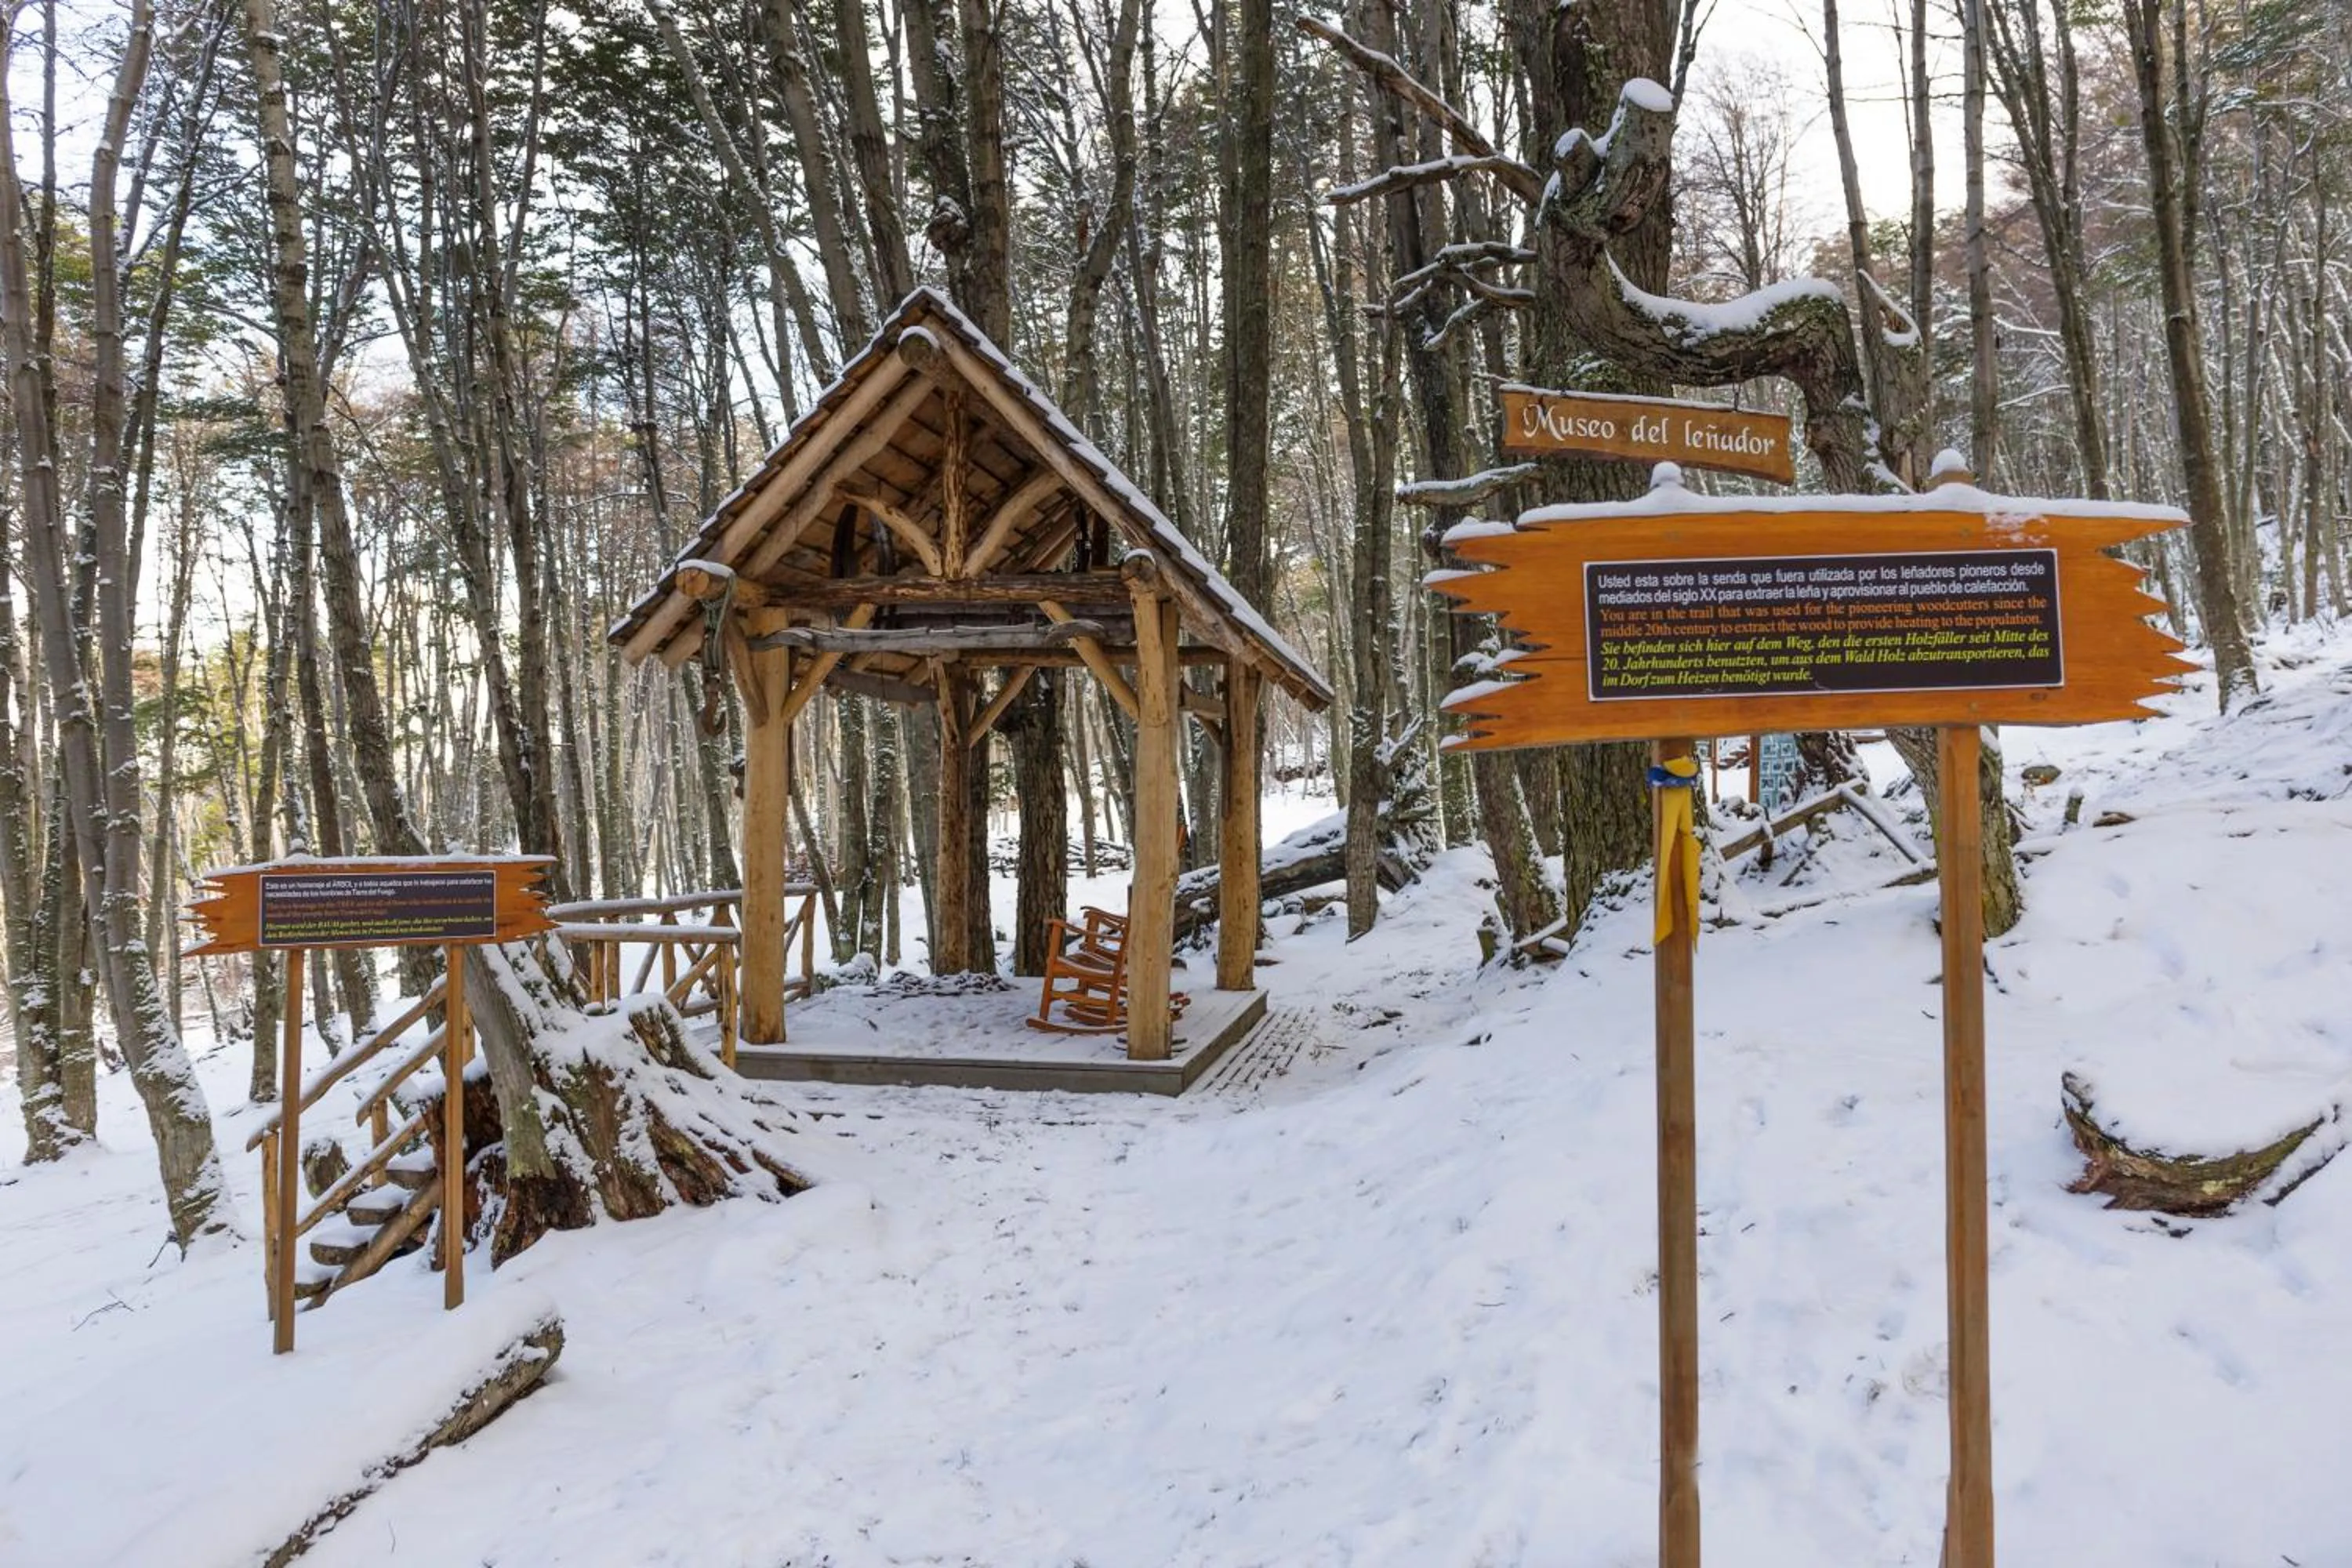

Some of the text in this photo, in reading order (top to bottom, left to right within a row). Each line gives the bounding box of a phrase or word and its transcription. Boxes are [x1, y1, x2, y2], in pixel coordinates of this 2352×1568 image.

[1523, 404, 1775, 455] Museo del leñador
[1598, 574, 1631, 588] Usted
[1663, 572, 1694, 586] sobre
[1698, 572, 1709, 585] la
[1712, 571, 1748, 585] senda
[1751, 572, 1773, 586] que
[1776, 568, 1805, 583] fuera
[1809, 567, 1855, 582] utilizada
[1859, 569, 1877, 583] por
[1881, 566, 1896, 580] los
[1900, 564, 1956, 579] leñadores
[1960, 564, 2007, 581] pioneros
[2010, 561, 2045, 576] desde
[1599, 578, 2029, 605] mediados del siglo XX para extraer la leña y aprovisionar al pueblo de calefacción.
[1600, 596, 2047, 622] You are in the trail that was used for the pioneering woodcutters since the
[1601, 612, 2043, 637] middle 20th century to extract the wood to provide heating to the population.
[1601, 641, 1621, 655] Sie
[1623, 640, 1676, 657] befinden
[1679, 639, 1702, 653] sich
[1706, 637, 1731, 652] hier
[1733, 637, 1758, 654] auf
[1756, 637, 1782, 650] dem
[1818, 634, 1842, 648] den
[1843, 634, 1862, 647] die
[1865, 635, 1902, 647] ersten
[1905, 632, 1967, 648] Holzfäller
[1969, 630, 1991, 644] seit
[1993, 630, 2027, 643] Mitte
[2027, 628, 2049, 641] des
[1602, 656, 1620, 670] 20.
[1622, 655, 1704, 670] Jahrhunderts
[1770, 655, 1788, 666] um
[1789, 655, 1813, 665] aus
[1814, 651, 1842, 664] dem
[1845, 648, 1875, 662] Wald
[1877, 648, 1906, 662] Holz
[2027, 644, 2051, 659] das
[1602, 667, 1813, 688] im Dorf zum Heizen benötigt wurde.
